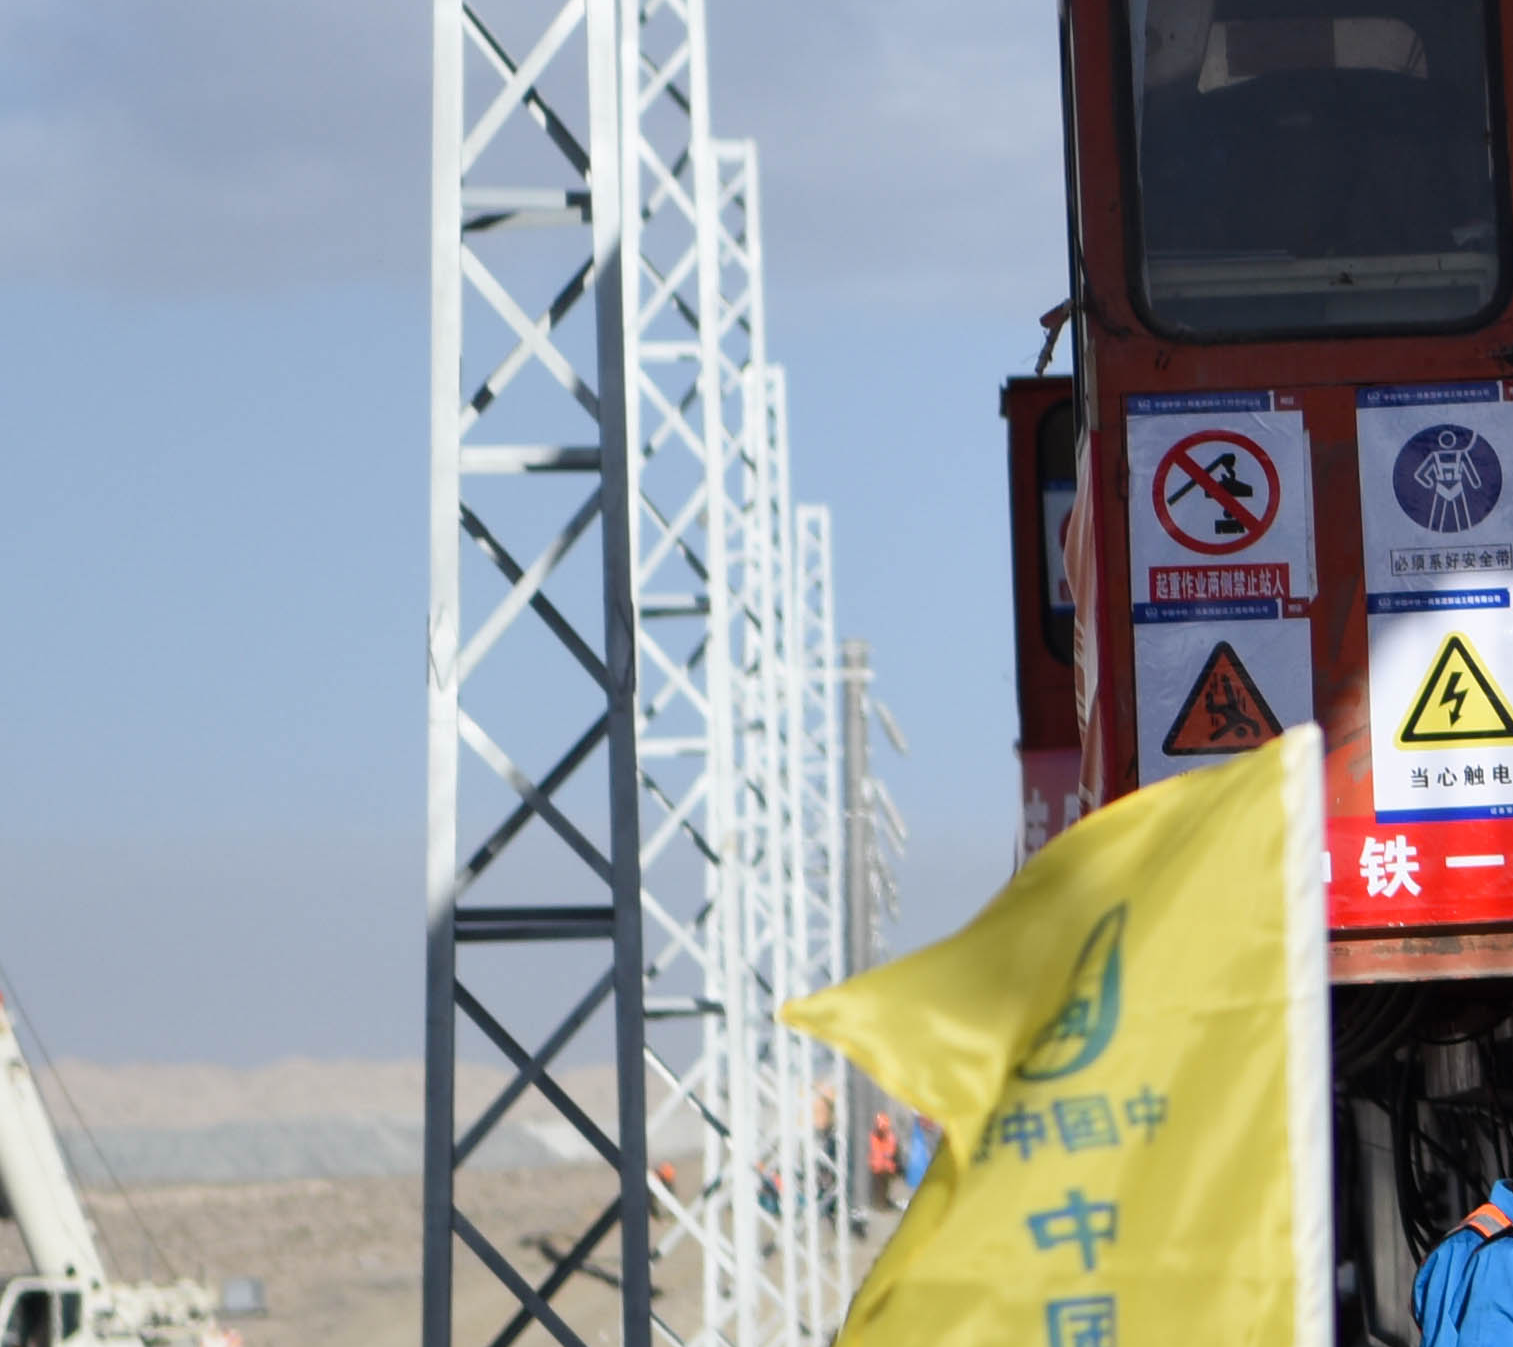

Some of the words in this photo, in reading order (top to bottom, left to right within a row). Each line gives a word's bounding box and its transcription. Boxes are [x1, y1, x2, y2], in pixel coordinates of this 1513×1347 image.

[1394, 548, 1513, 572] 必须系好安全带
[1154, 565, 1286, 599] 起重作业两侧禁止站人
[1409, 763, 1513, 791] 当心触电
